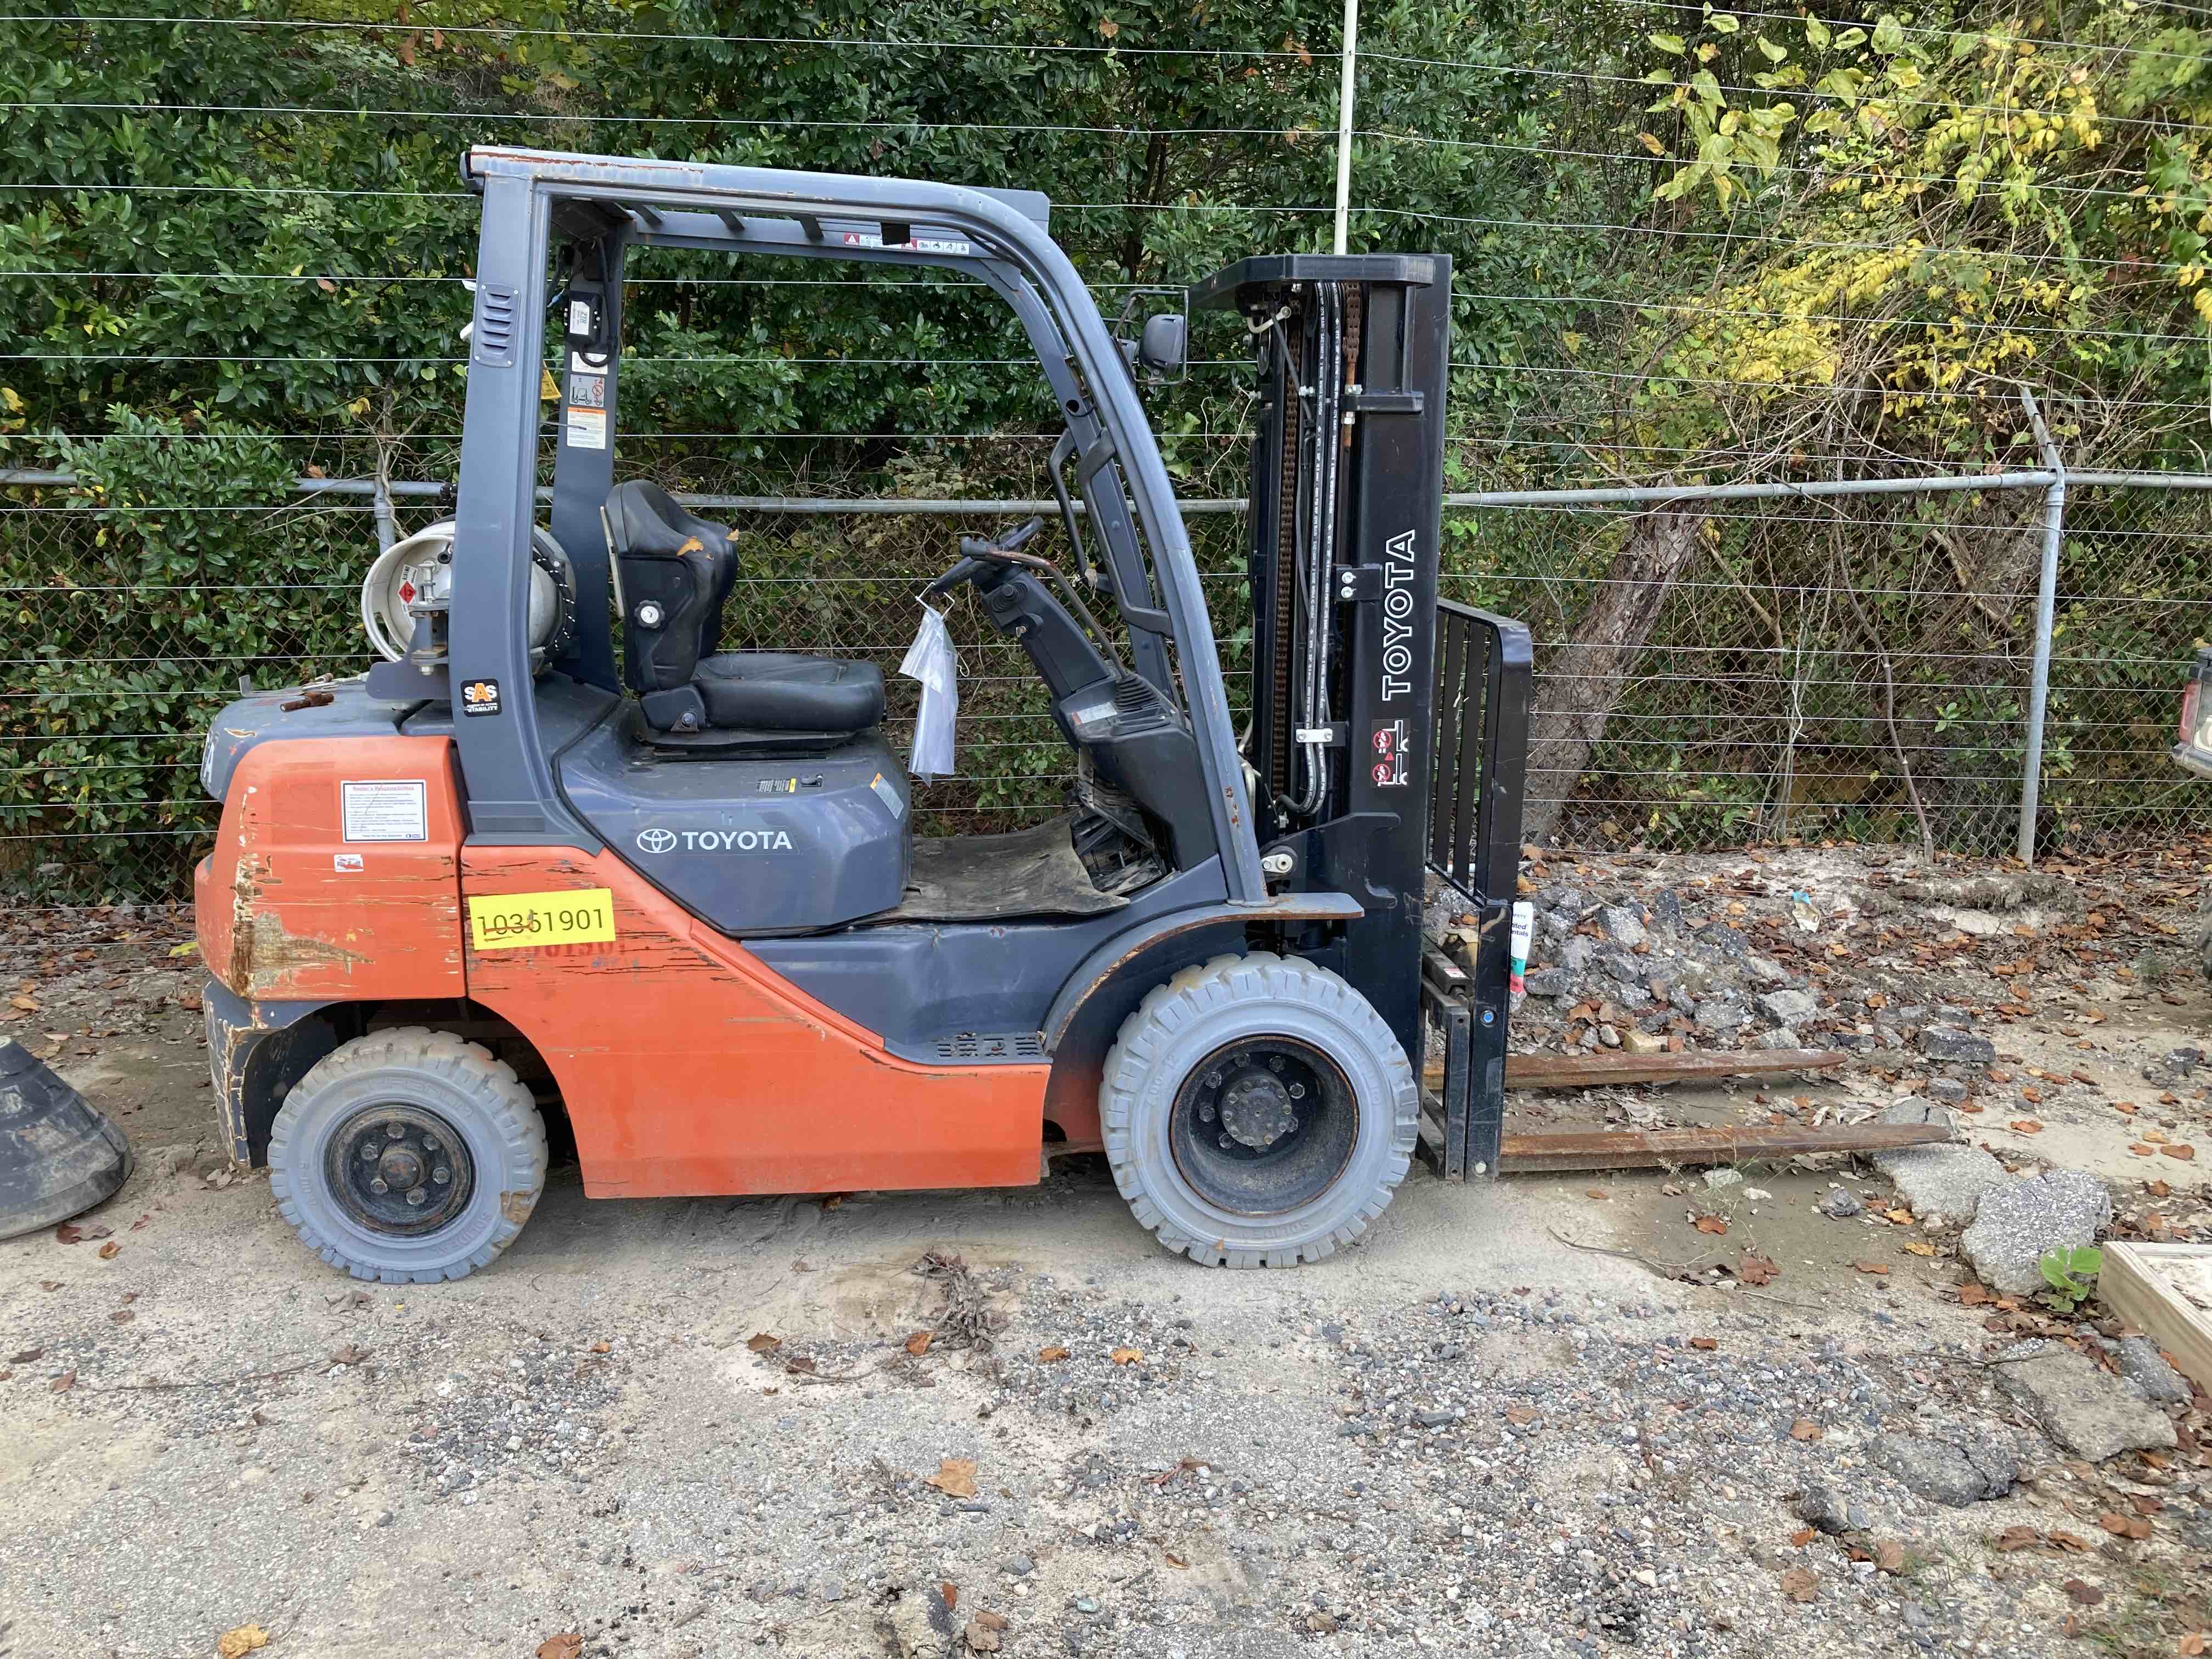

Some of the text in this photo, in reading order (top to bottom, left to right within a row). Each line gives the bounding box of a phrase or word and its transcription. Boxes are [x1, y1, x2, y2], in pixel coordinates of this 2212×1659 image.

[1382, 529, 1415, 702] TOYOTA
[464, 682, 497, 703] SAS
[681, 831, 793, 850] TOYOTA
